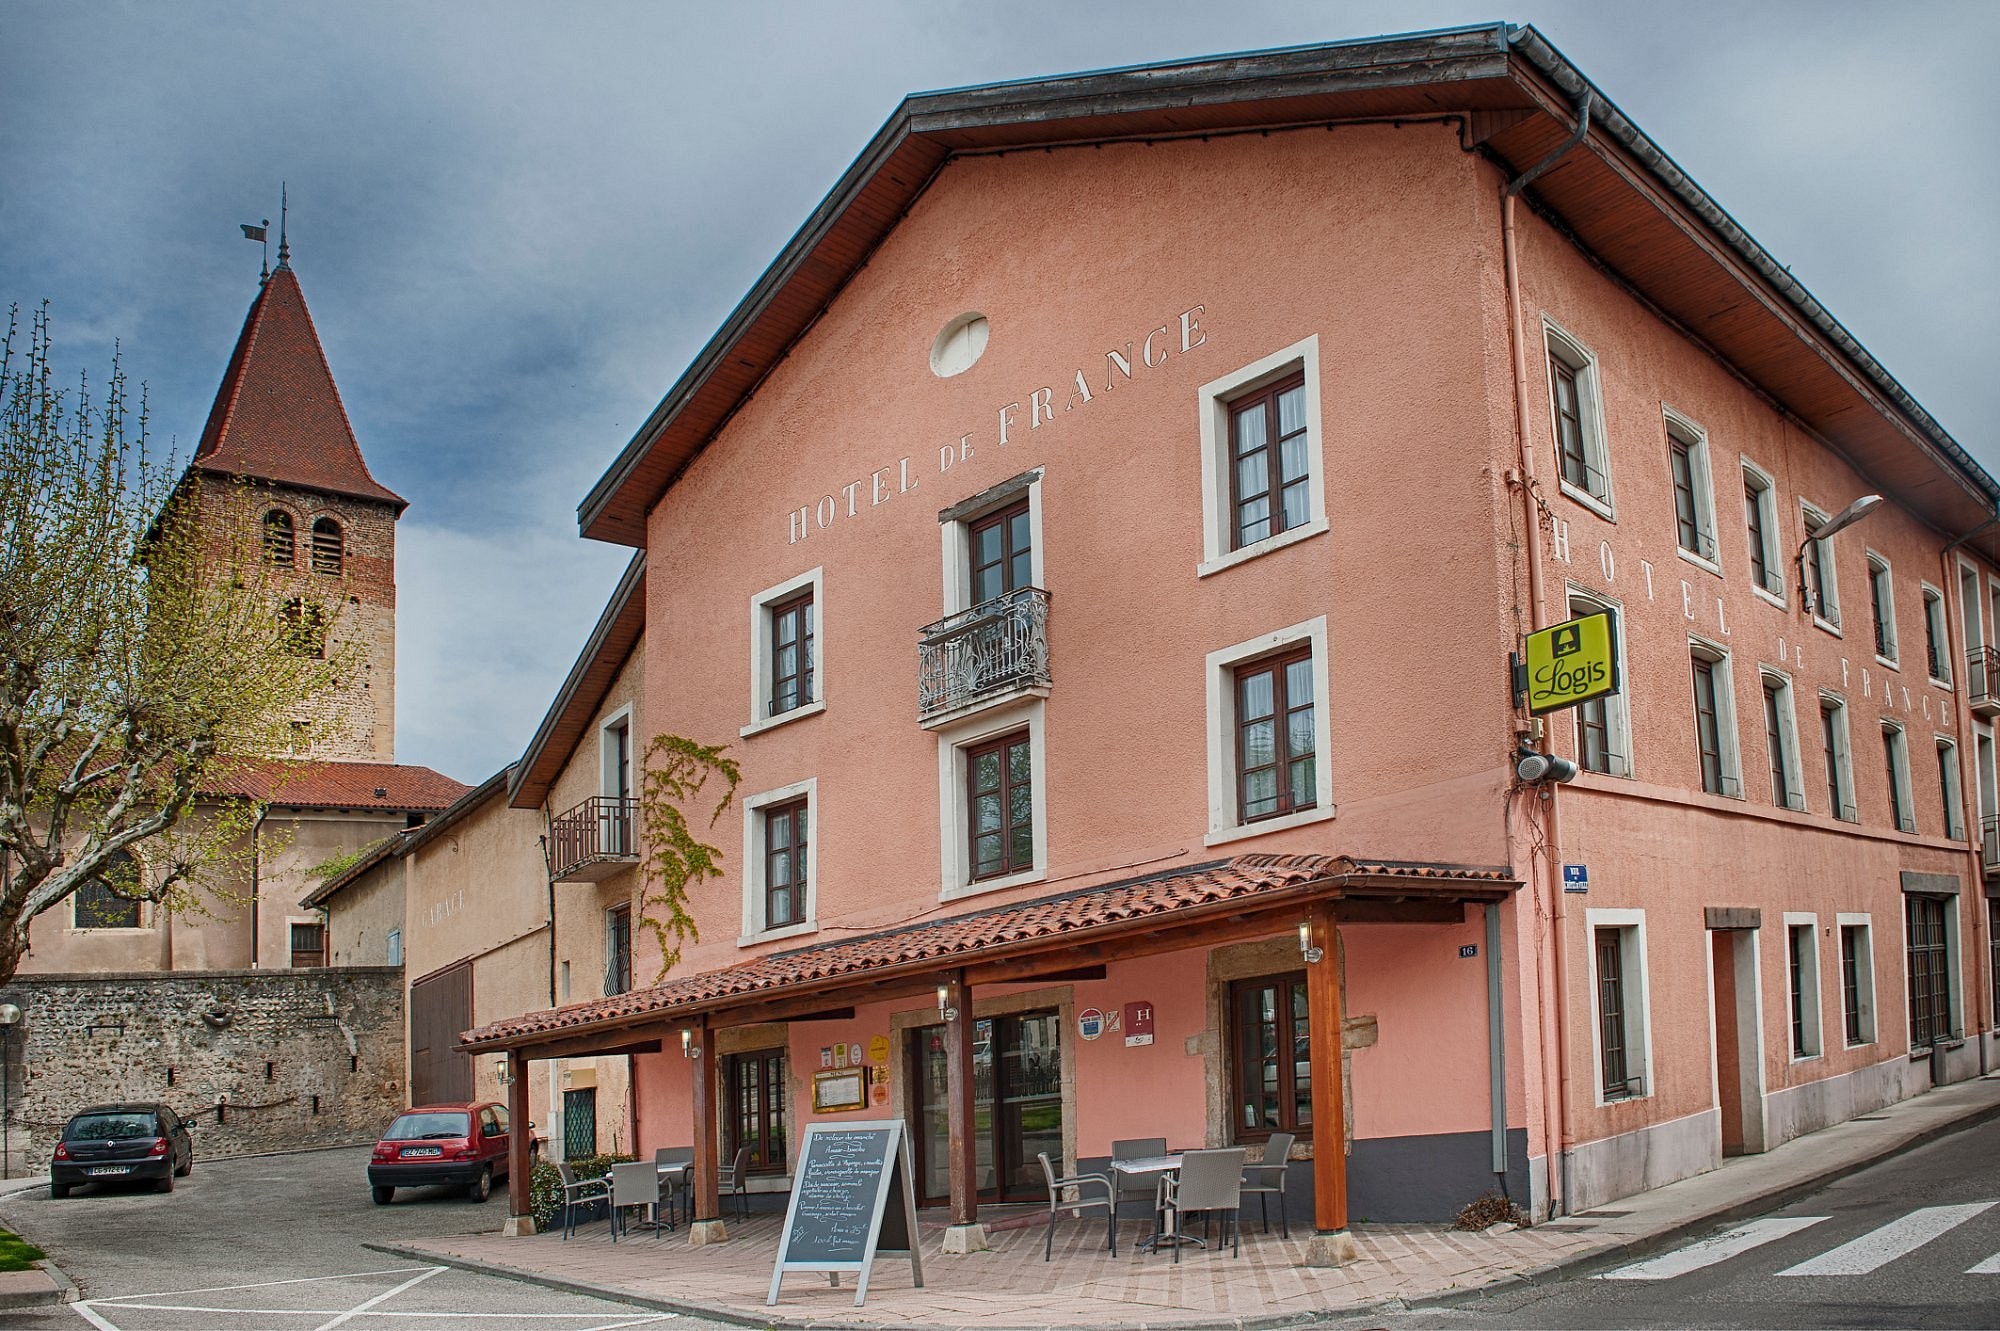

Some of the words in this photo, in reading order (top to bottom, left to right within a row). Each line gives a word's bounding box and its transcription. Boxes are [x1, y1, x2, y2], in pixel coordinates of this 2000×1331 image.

[788, 457, 919, 545] HOTEL
[939, 433, 975, 473] DE
[998, 304, 1208, 446] FRANCE
[1552, 516, 1731, 636] HOTEL
[1779, 637, 1804, 669] DE
[1842, 657, 1950, 726] FRANCE
[1533, 659, 1606, 701] Logis
[422, 889, 465, 928] GARAGE
[1463, 946, 1474, 956] 16
[1136, 1008, 1152, 1021] H
